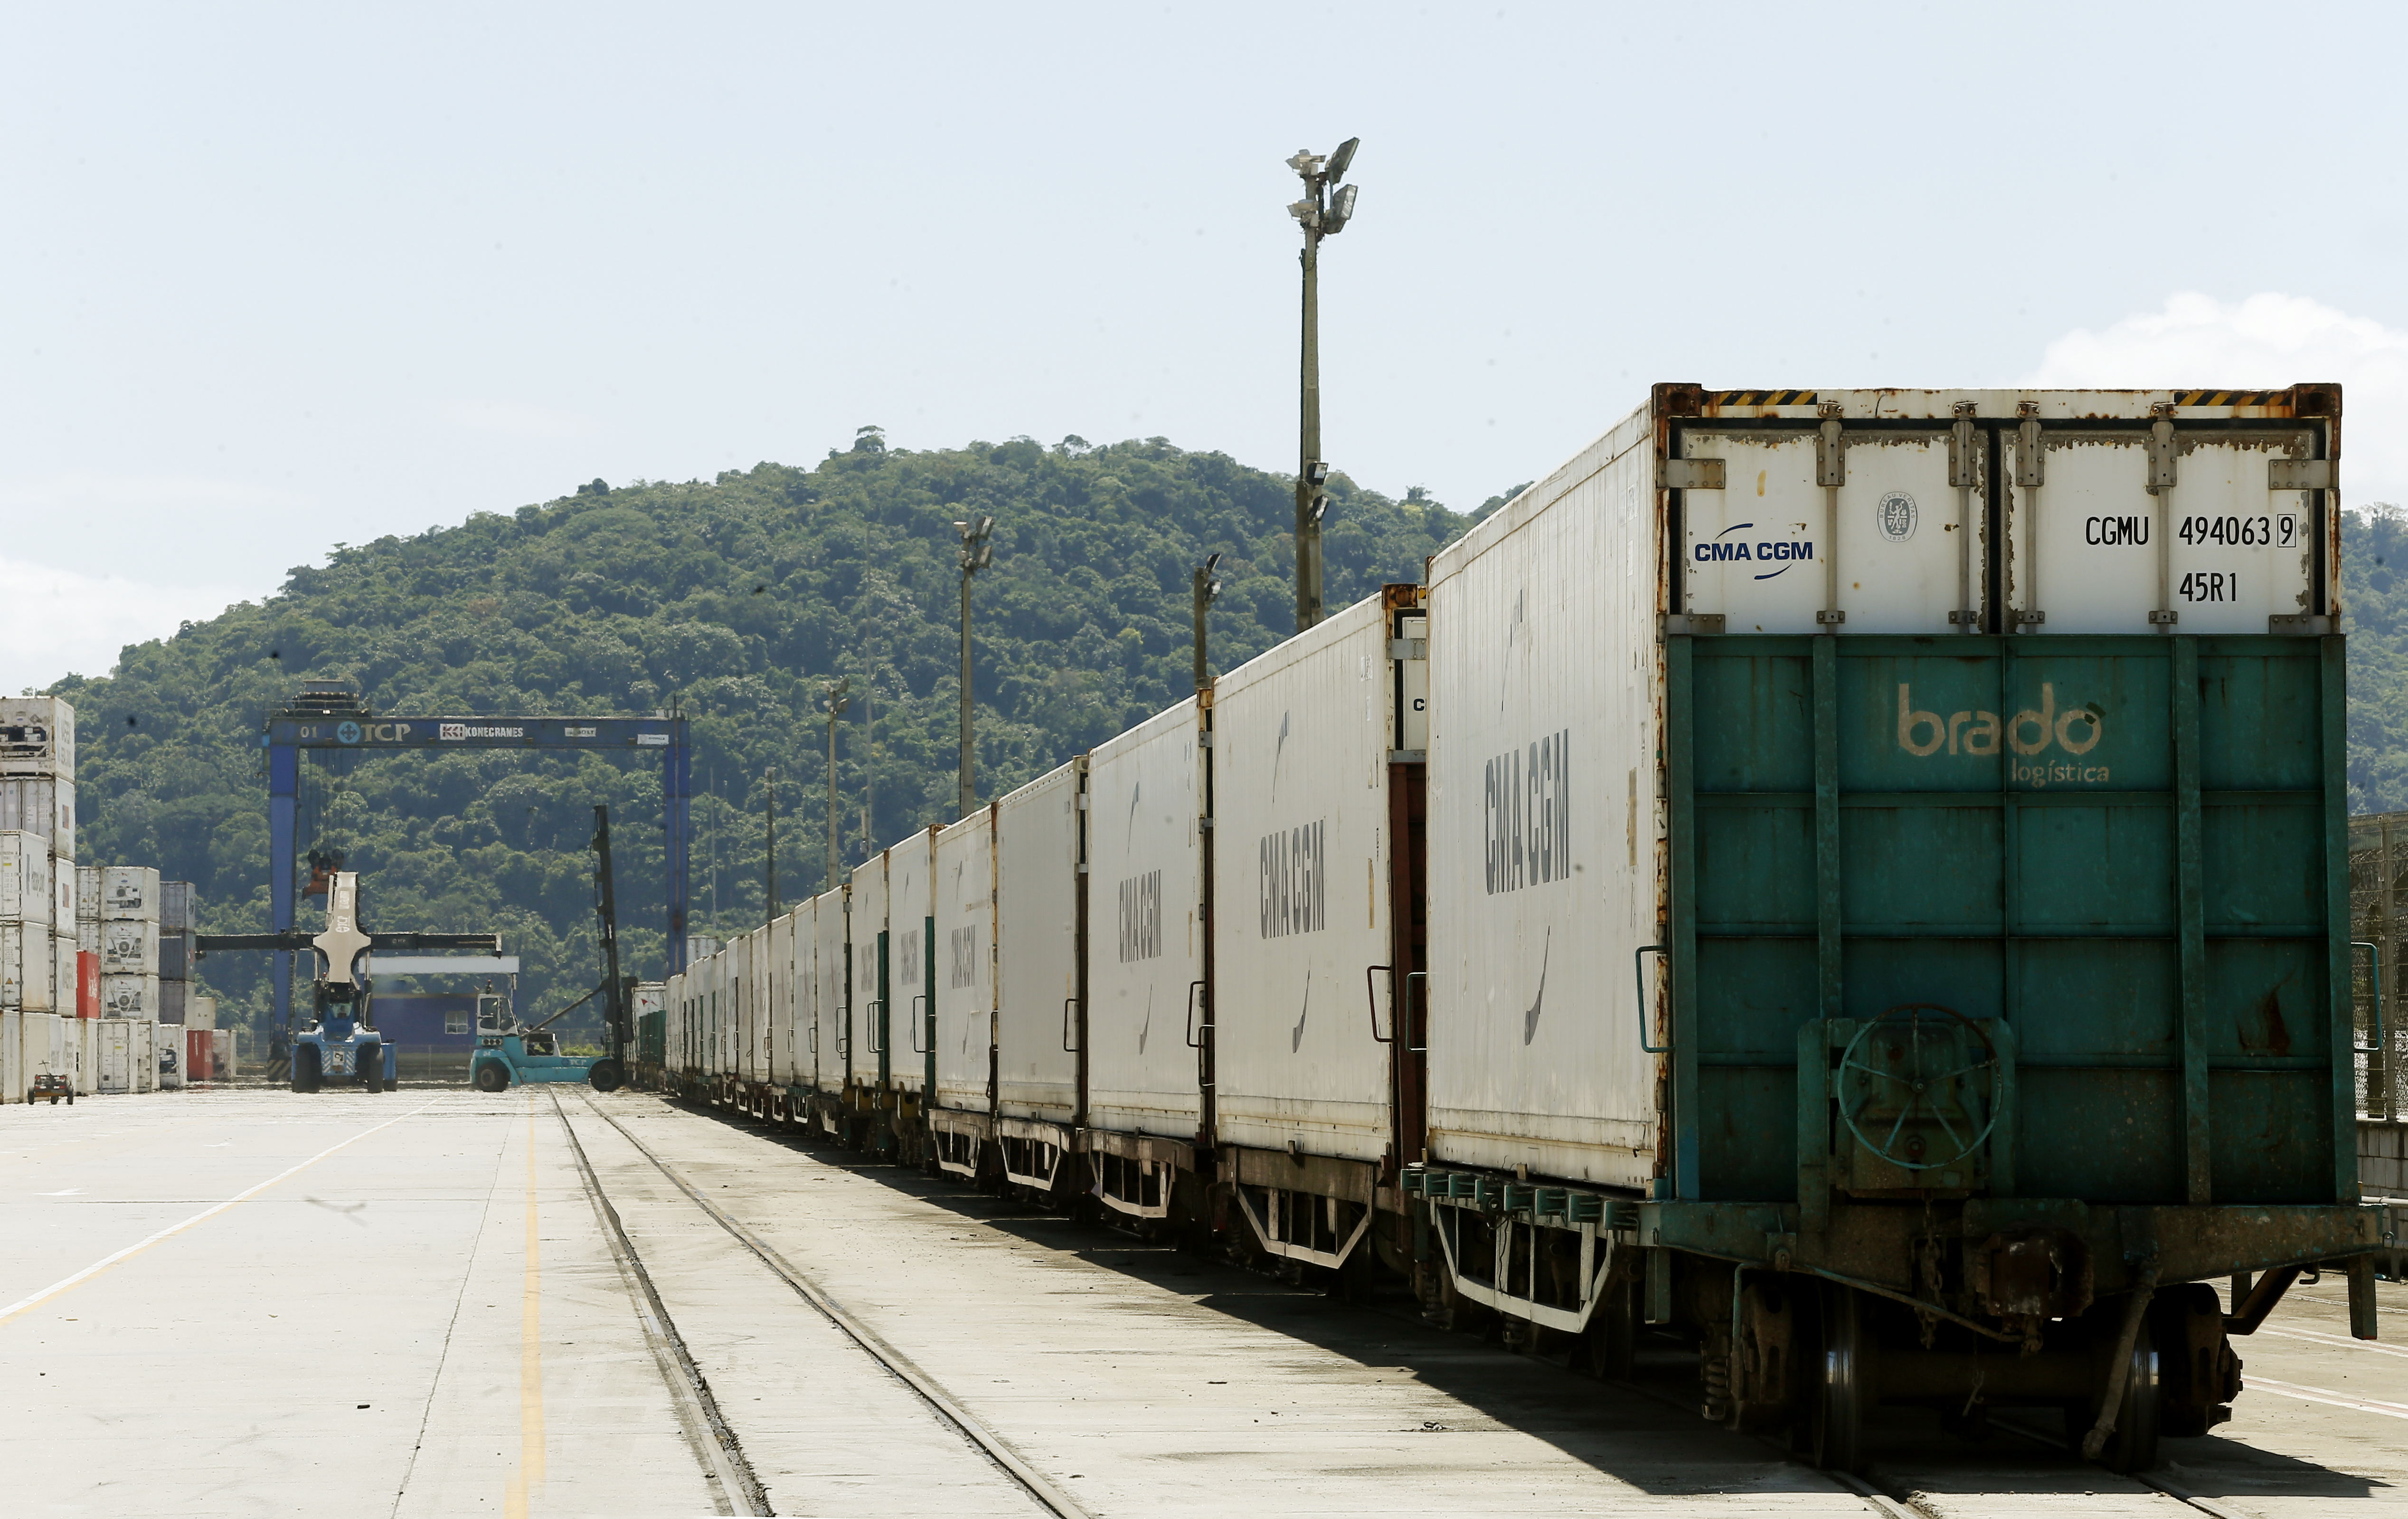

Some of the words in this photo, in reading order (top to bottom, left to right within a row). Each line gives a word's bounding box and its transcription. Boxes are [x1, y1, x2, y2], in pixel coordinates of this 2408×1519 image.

[1879, 493, 1896, 518] BUREAU
[1898, 493, 1916, 519] VERITAS
[2086, 516, 2149, 545] CGMU
[2179, 516, 2270, 545] 494063
[2280, 516, 2294, 546] 9
[1695, 543, 1752, 561] CMA
[1757, 542, 1813, 560] CGM
[2179, 572, 2236, 602] 45R1
[300, 726, 318, 739] 01
[360, 723, 411, 742] TCP
[465, 727, 523, 738] KONECRANES
[1898, 683, 2102, 757] brado
[2011, 758, 2110, 788] logística
[1485, 748, 1523, 896] CMA
[1528, 727, 1570, 887] CGM
[1260, 829, 1289, 940] CMA
[1293, 819, 1325, 935] CGM
[1119, 876, 1139, 964] CMA
[1141, 869, 1161, 959] CGM
